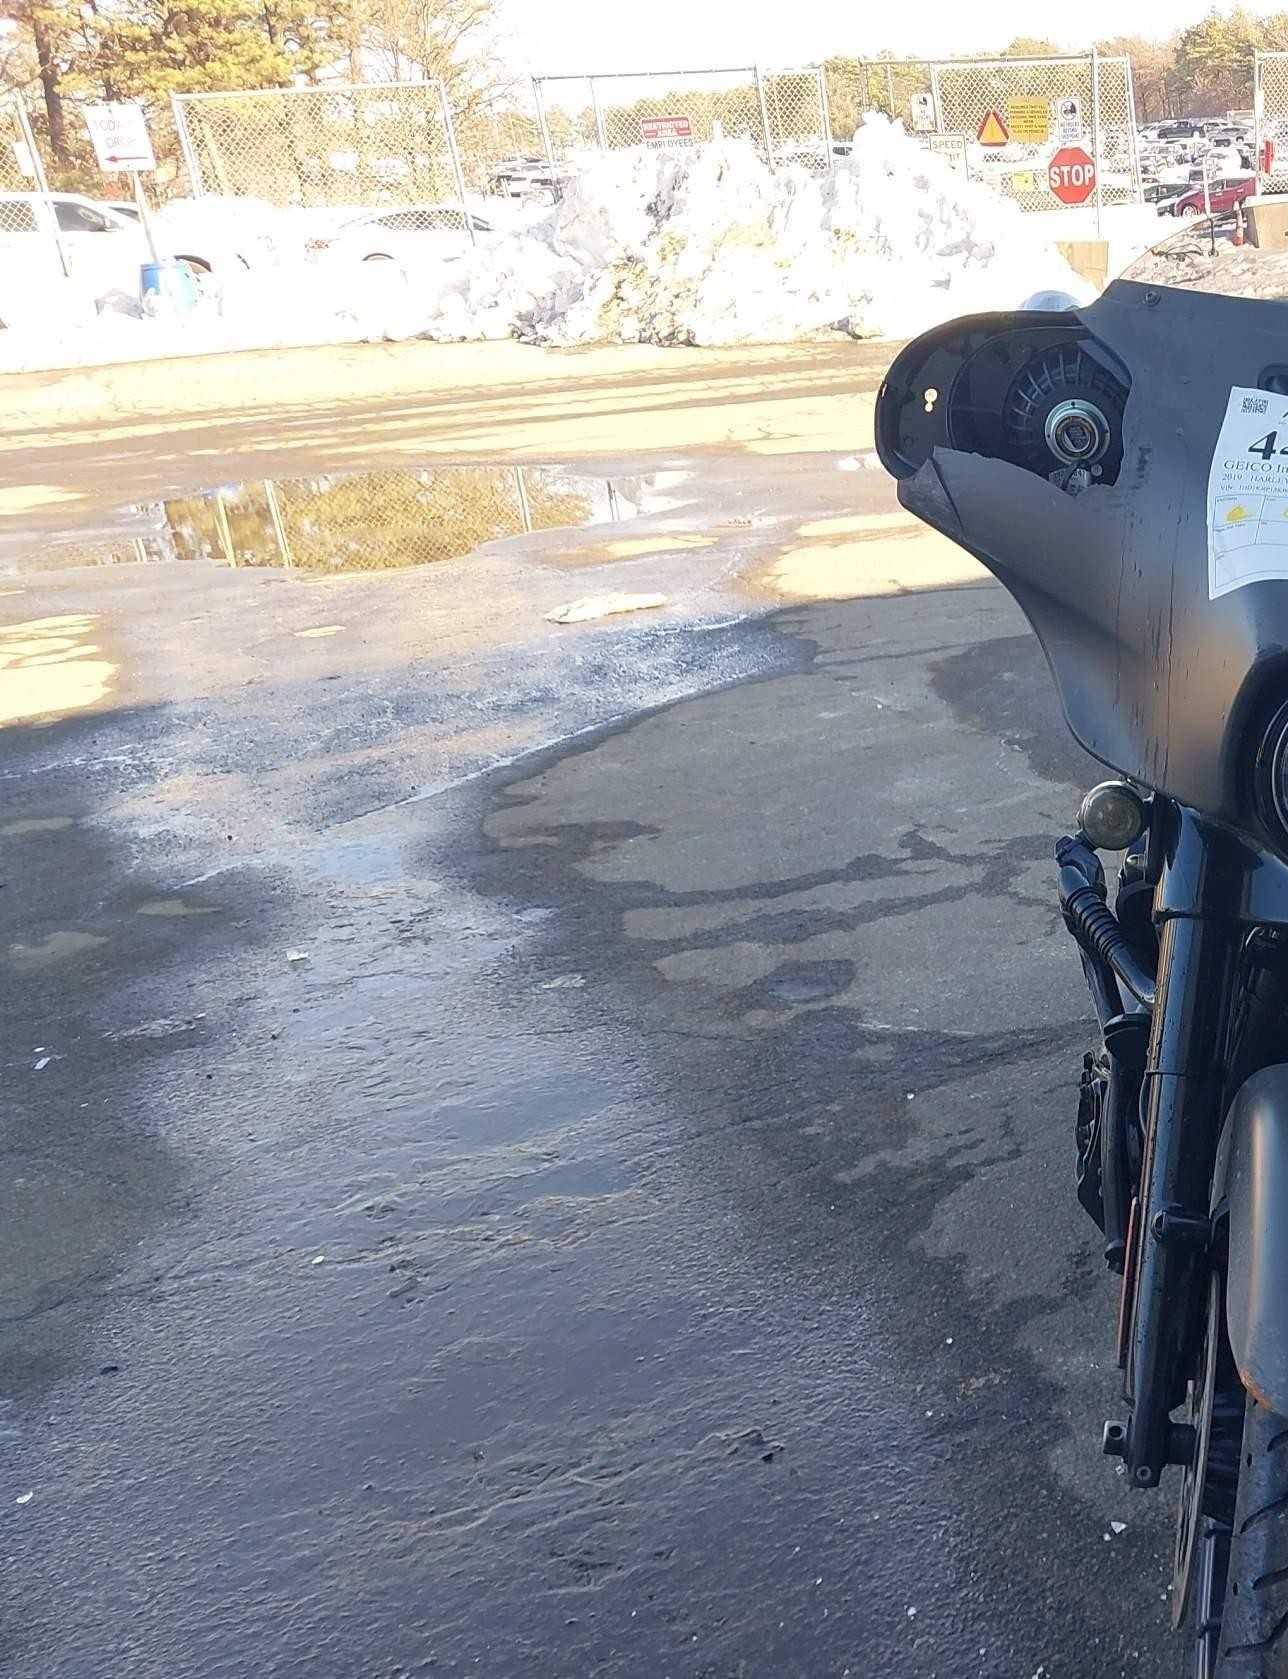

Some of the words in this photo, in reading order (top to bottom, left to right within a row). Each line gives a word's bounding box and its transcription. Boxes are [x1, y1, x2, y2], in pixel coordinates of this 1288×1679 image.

[646, 138, 694, 149] EMPLOYEES
[933, 140, 963, 149] SPEED
[1049, 164, 1094, 189] STOP
[1223, 460, 1272, 472] GEICO
